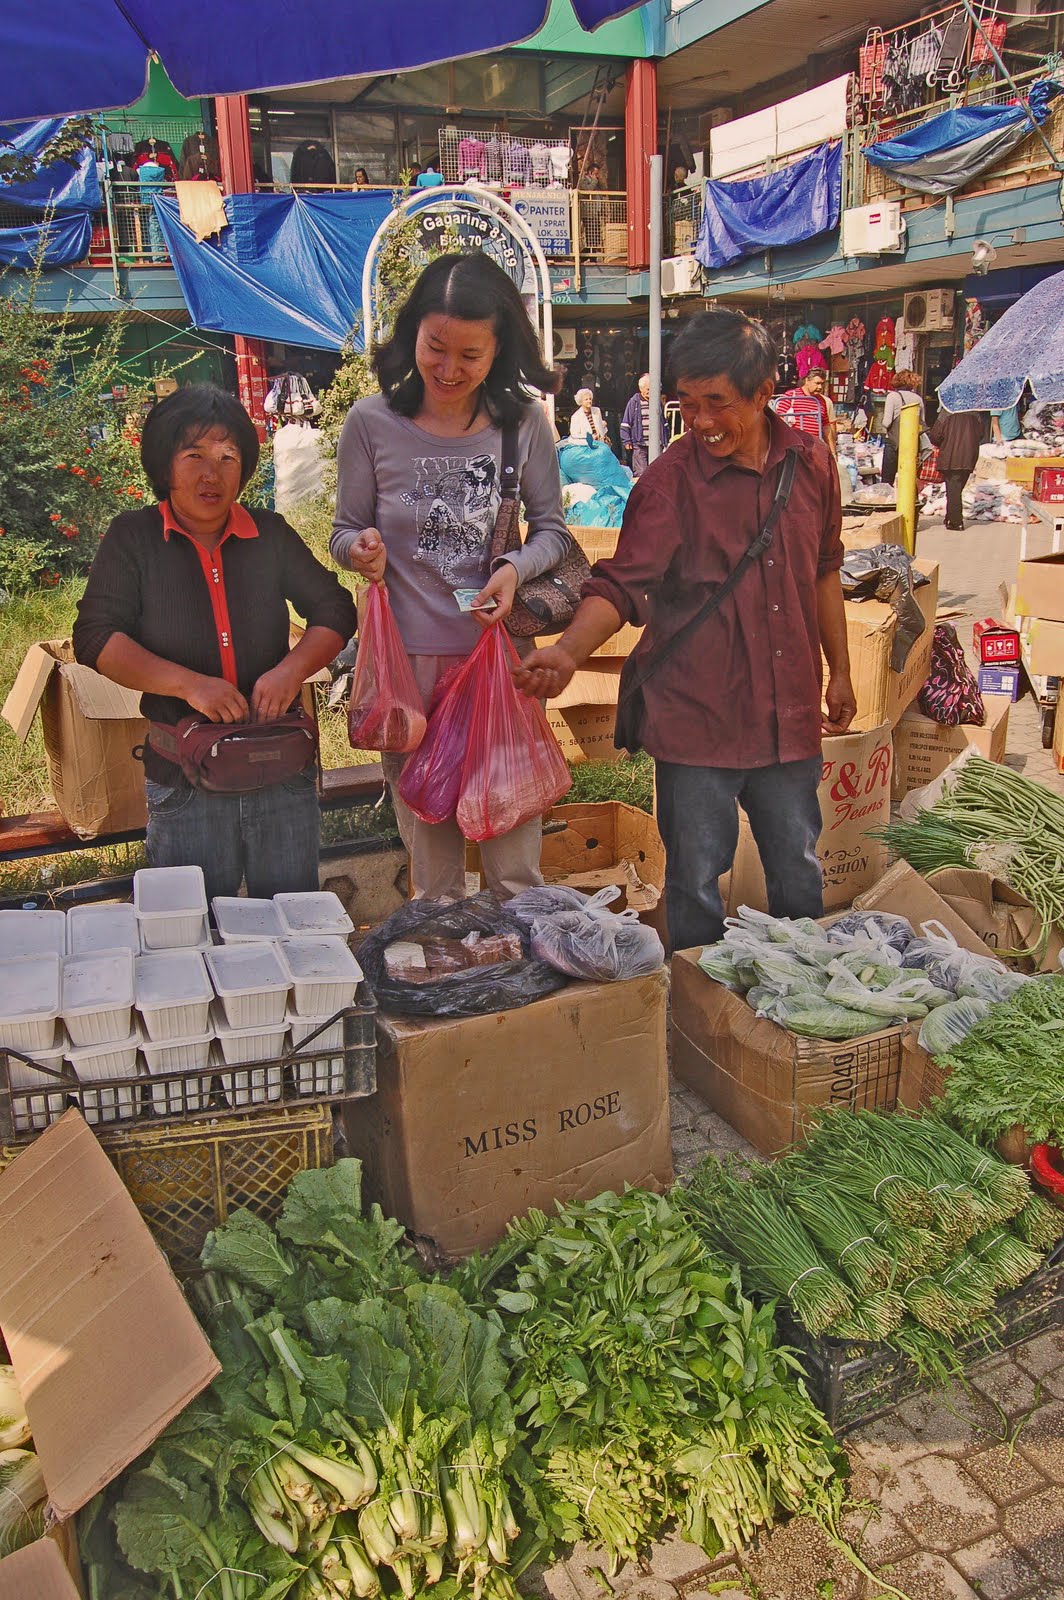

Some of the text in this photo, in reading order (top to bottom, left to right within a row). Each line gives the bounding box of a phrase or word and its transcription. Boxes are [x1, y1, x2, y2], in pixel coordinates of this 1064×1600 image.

[530, 206, 565, 216] PANTER
[545, 219, 566, 227] SPRAT
[423, 212, 517, 267] Gagarina 87-89
[556, 229, 568, 237] 355
[440, 234, 482, 247] Blok 70
[553, 239, 566, 247] 222
[553, 247, 566, 255] 968
[830, 762, 862, 802] &
[830, 798, 887, 831] Jeans
[821, 855, 869, 877] ASHION
[463, 1090, 622, 1158] MISS ROSE
